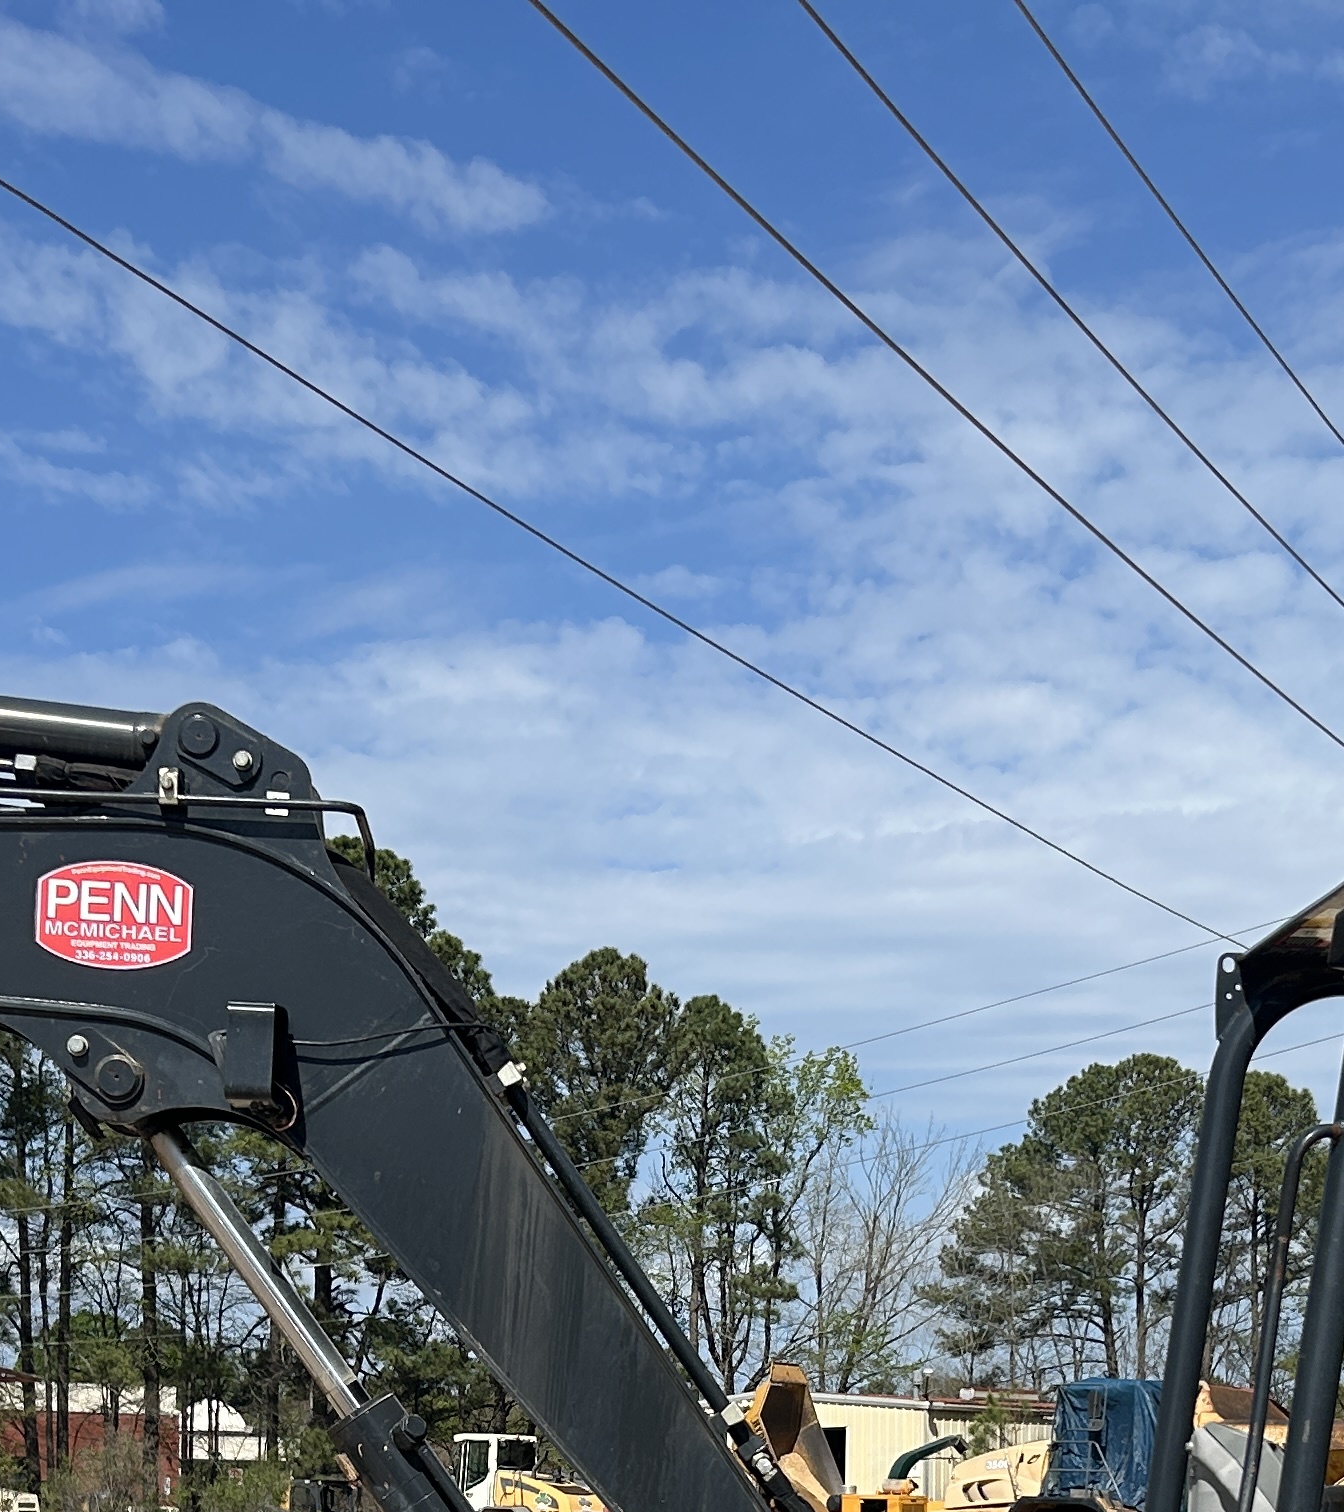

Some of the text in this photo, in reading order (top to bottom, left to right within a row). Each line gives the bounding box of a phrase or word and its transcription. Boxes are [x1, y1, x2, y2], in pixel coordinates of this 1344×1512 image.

[46, 878, 184, 926] PENN
[44, 920, 183, 943] MCMICHAEL
[70, 940, 156, 952] EQUIPMENT TRADING
